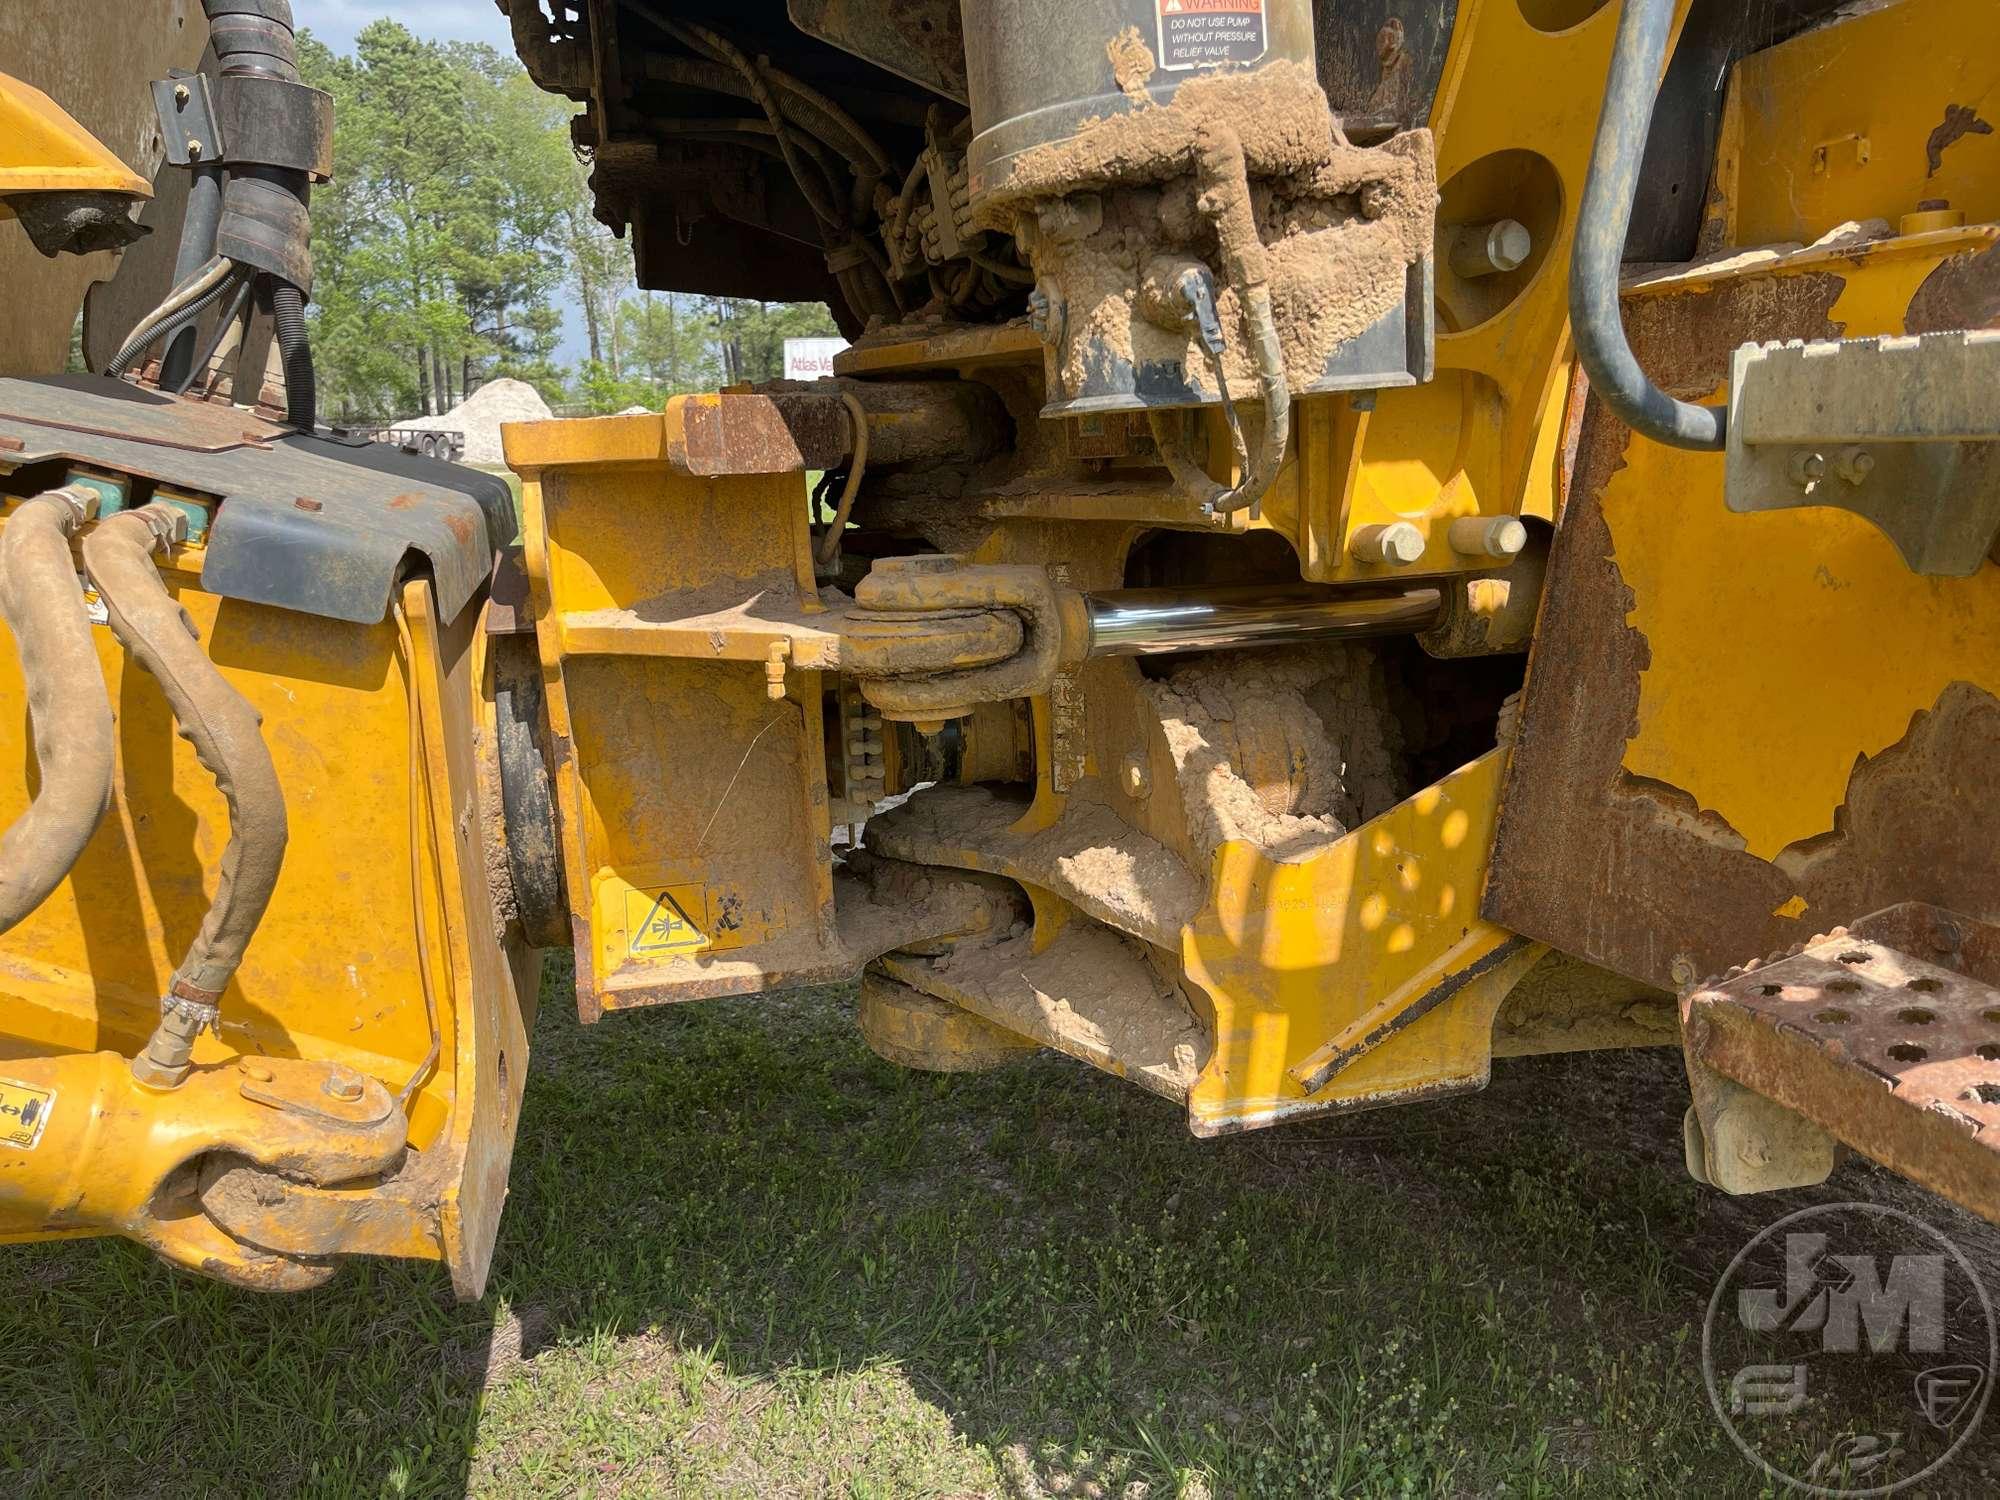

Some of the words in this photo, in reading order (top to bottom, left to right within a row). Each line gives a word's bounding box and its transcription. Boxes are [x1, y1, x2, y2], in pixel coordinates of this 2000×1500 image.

[1171, 19, 1186, 30] DO
[1187, 17, 1206, 28] NOT
[1208, 17, 1226, 27] USE
[1227, 16, 1250, 27] PUMP
[1172, 32, 1212, 44] WITHOUT
[1215, 31, 1256, 42] PRESSURE
[1173, 47, 1202, 58] RELIEF
[1204, 46, 1230, 57] VALVE
[791, 356, 818, 371] Atlas
